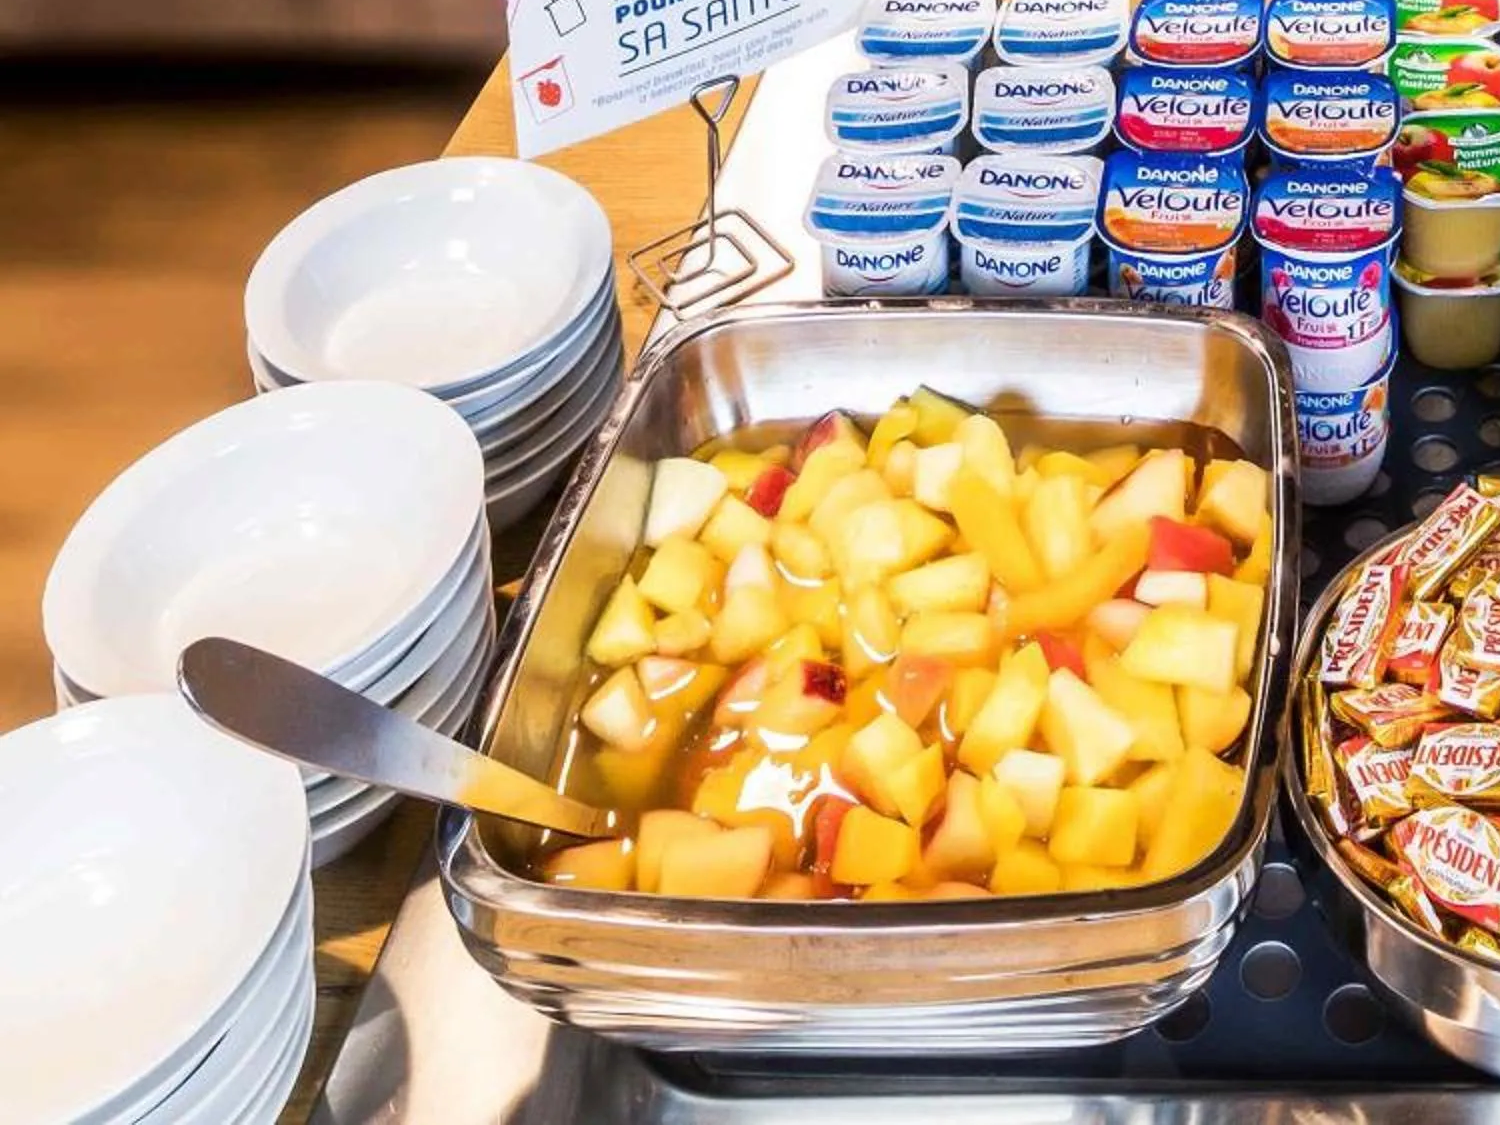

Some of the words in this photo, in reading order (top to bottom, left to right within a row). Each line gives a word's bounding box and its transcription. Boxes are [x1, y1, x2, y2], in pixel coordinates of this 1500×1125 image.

[885, 0, 980, 13] DANONE
[1014, 0, 1110, 15] DANONE
[1165, 2, 1239, 14] DANONE
[1292, 1, 1365, 13] DANONE
[1146, 13, 1257, 35] Velouté
[1274, 13, 1387, 35] Velouté
[618, 21, 667, 65] SA
[994, 78, 1096, 97] DANONE
[1151, 77, 1229, 92] DANONE
[1293, 84, 1371, 96] DANONE
[1131, 93, 1249, 117] Velouté
[1273, 99, 1393, 120] Velouté
[980, 168, 1086, 190] DANONE
[1137, 165, 1219, 183] DANONE
[1288, 182, 1369, 194] DANONE
[1115, 186, 1242, 212] Velouté
[1266, 197, 1391, 219] Velouté
[836, 245, 925, 271] DANONE
[976, 250, 1061, 277] DANONE
[1137, 263, 1207, 279] DANONE
[1284, 261, 1353, 281] DANONE
[1275, 287, 1371, 318] Velouté
[1296, 393, 1354, 409] ANONE
[1298, 412, 1371, 442] elouté
[1327, 570, 1384, 673] PRÉSIDENT
